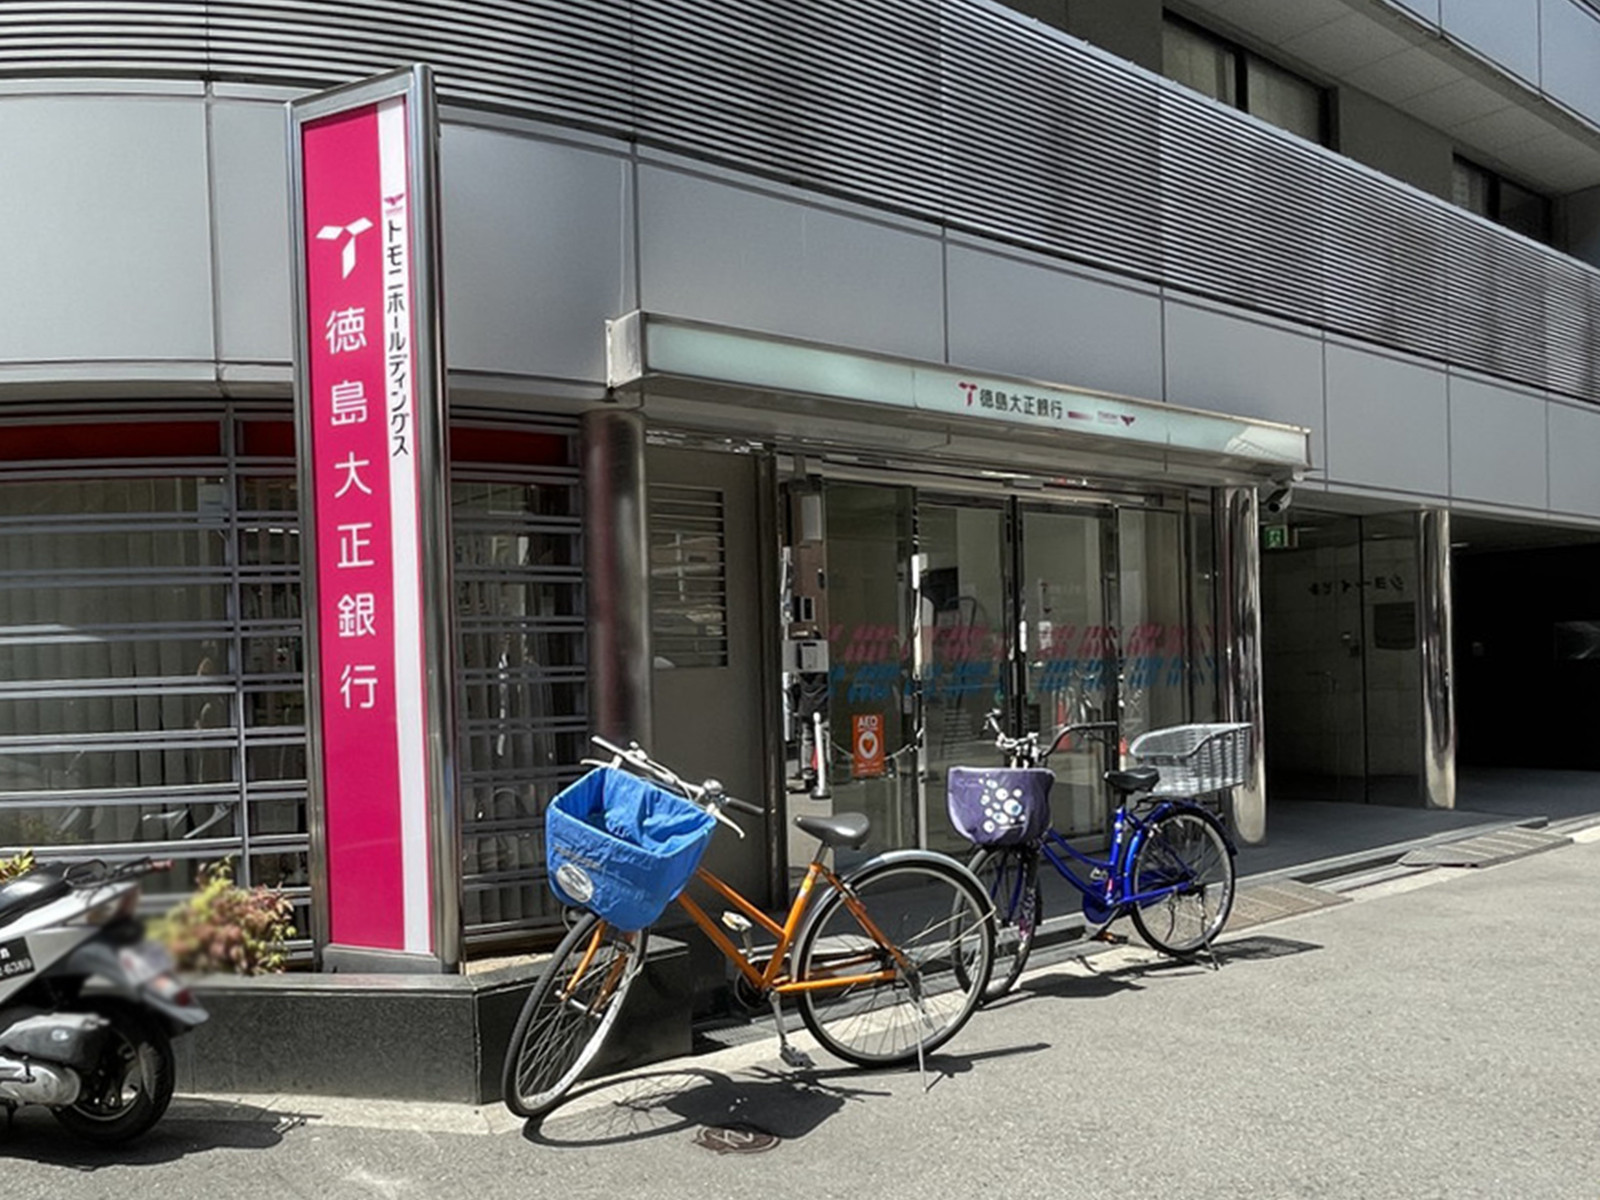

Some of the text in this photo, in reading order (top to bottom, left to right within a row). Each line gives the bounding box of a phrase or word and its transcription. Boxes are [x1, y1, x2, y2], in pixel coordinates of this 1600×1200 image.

[386, 219, 410, 457] トモニホールディングス
[980, 388, 1063, 419] 徳島大正銀行
[325, 306, 378, 709] 徳島大正銀行
